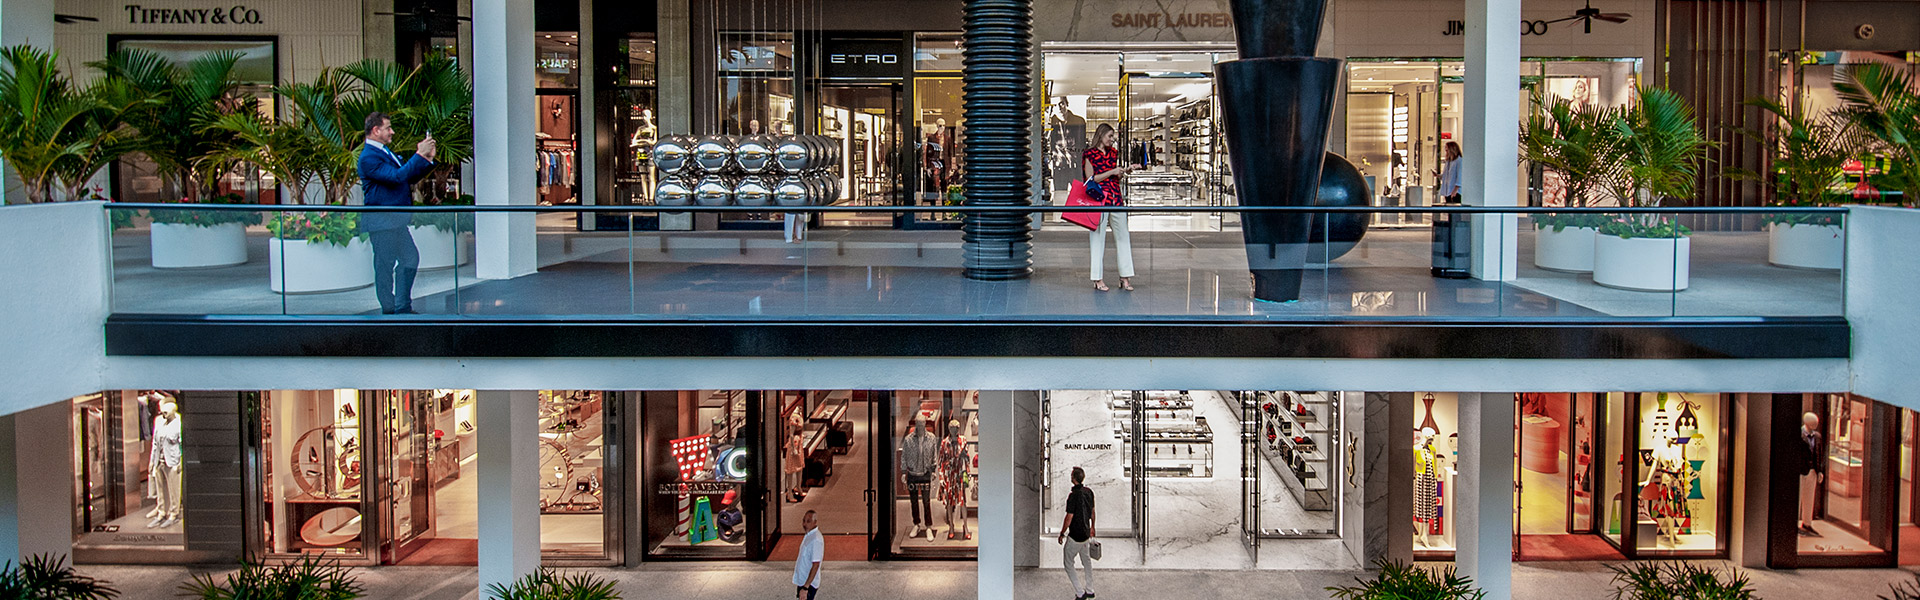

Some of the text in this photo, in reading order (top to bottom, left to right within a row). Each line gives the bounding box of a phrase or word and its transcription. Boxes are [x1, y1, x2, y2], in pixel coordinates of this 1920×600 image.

[125, 5, 209, 24] TIFFANY
[211, 7, 227, 24] &
[1111, 13, 1234, 28] SAINT LAUREN
[1442, 20, 1465, 36] JIM
[830, 54, 897, 64] ETRO
[659, 483, 699, 491] BOTTGA
